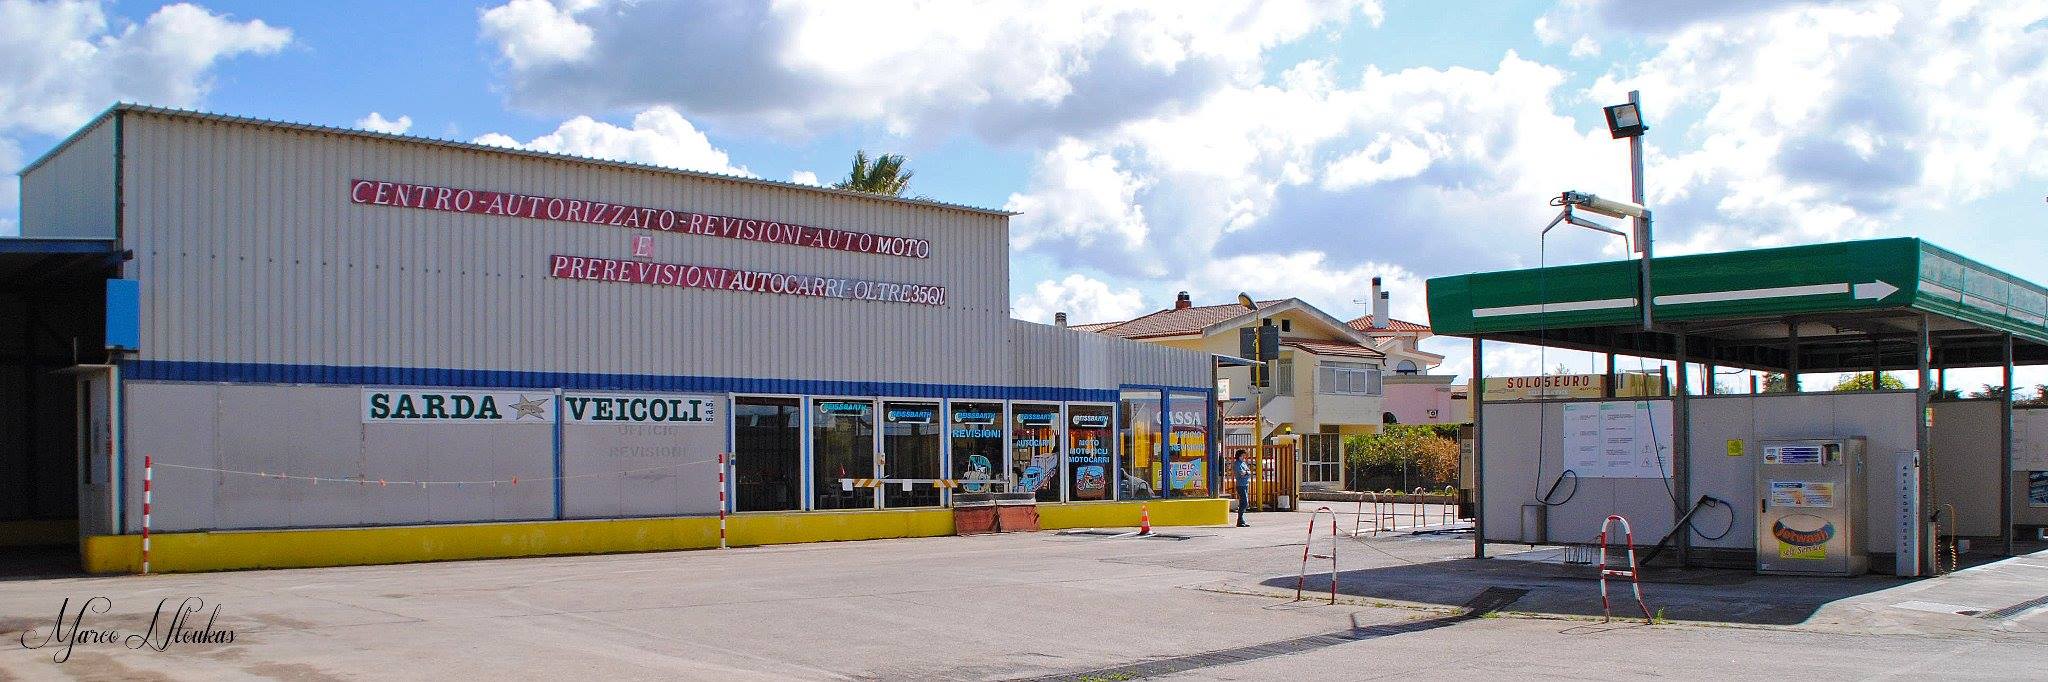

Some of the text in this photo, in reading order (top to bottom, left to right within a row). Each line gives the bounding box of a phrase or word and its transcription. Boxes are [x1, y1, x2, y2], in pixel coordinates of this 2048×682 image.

[634, 236, 652, 257] E
[876, 237, 929, 259] MOTO
[552, 256, 726, 289] PREREVISIONI
[370, 393, 703, 422] SARDA VEICOLI
[952, 429, 1001, 438] REVISIONI
